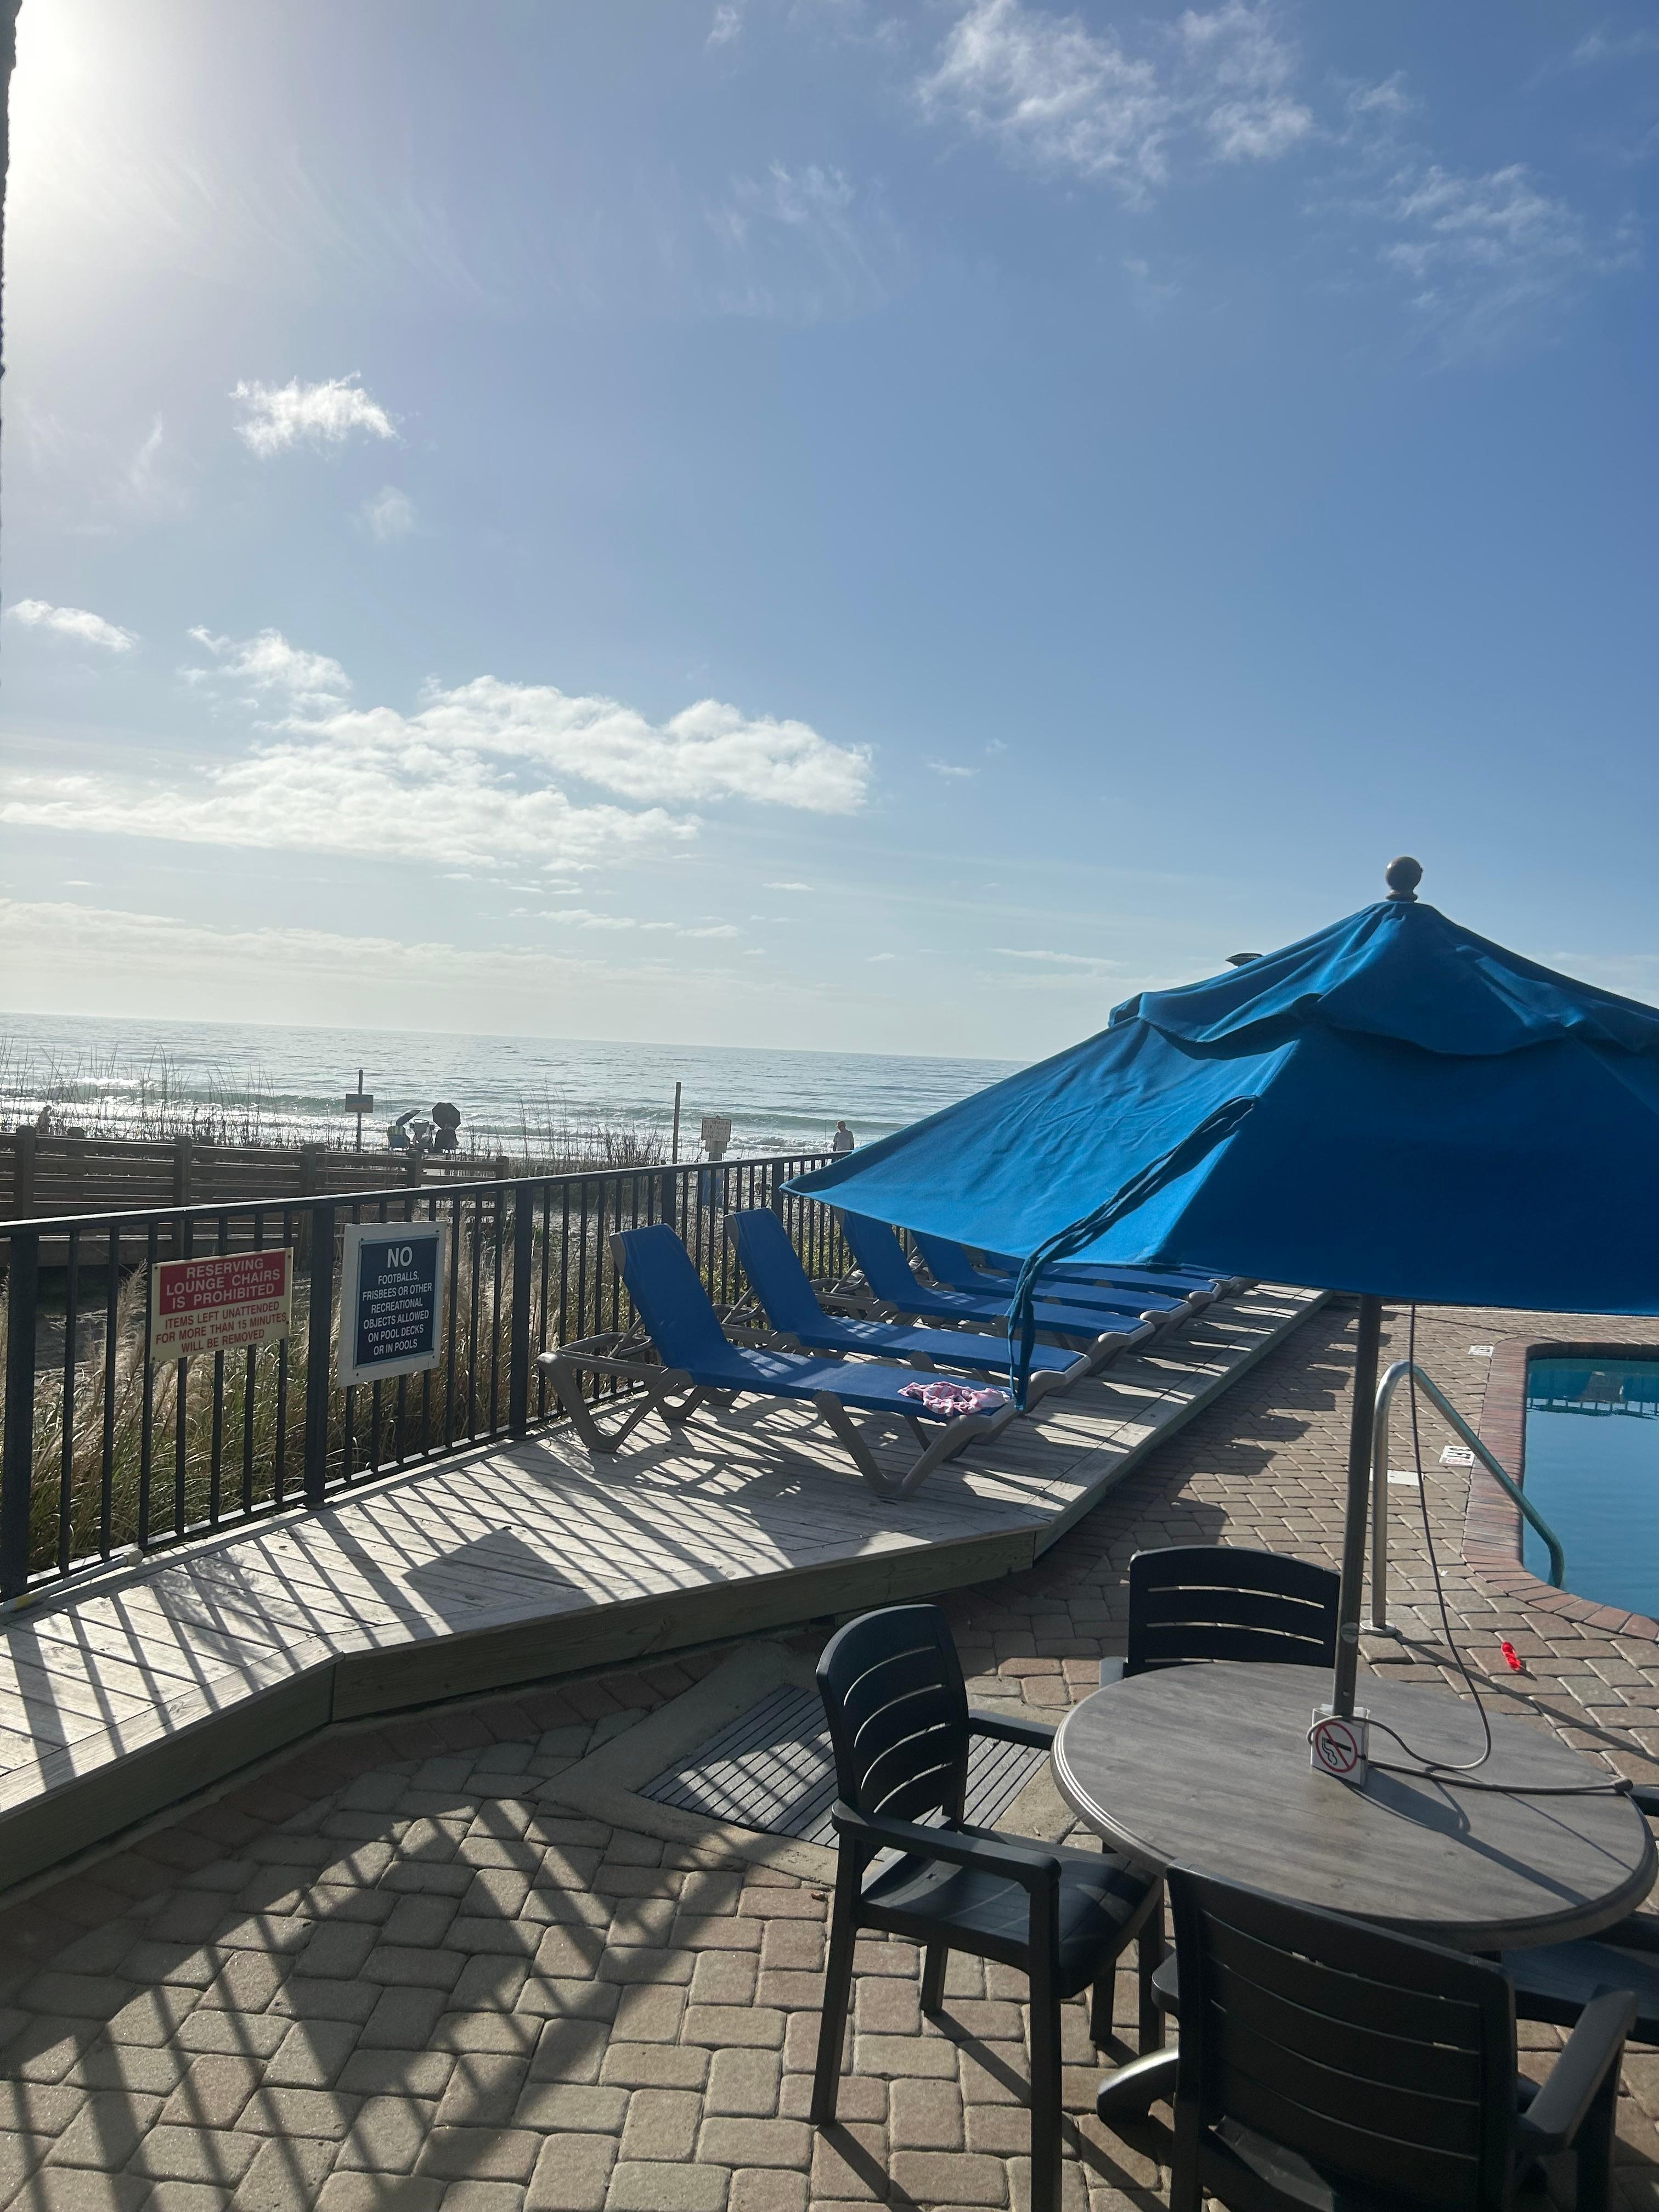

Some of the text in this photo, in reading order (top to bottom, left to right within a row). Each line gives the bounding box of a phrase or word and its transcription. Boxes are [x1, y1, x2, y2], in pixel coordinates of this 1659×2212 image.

[387, 1246, 413, 1268] NO
[187, 1258, 263, 1279] RESERVING
[378, 1271, 419, 1285] FOOTBALLS,
[167, 1269, 280, 1296] LOUNGE CHAIRS
[363, 1283, 432, 1301] FRISBEES OR OTHER
[173, 1283, 274, 1309] IS PROHIBITED
[371, 1297, 423, 1314] RECREATIONAL
[165, 1301, 279, 1329] ITEMS LEFT UNATTENDED
[363, 1310, 430, 1329] OBJECTS ALLOWED
[156, 1312, 286, 1344] FOR MORE THAN 15 MINUTES
[368, 1324, 424, 1342] ON POOL DECKS
[182, 1329, 264, 1353] WILL BE REMOVED
[374, 1339, 417, 1356] OR IN POOLS
[1446, 1451, 1471, 1459] FT
